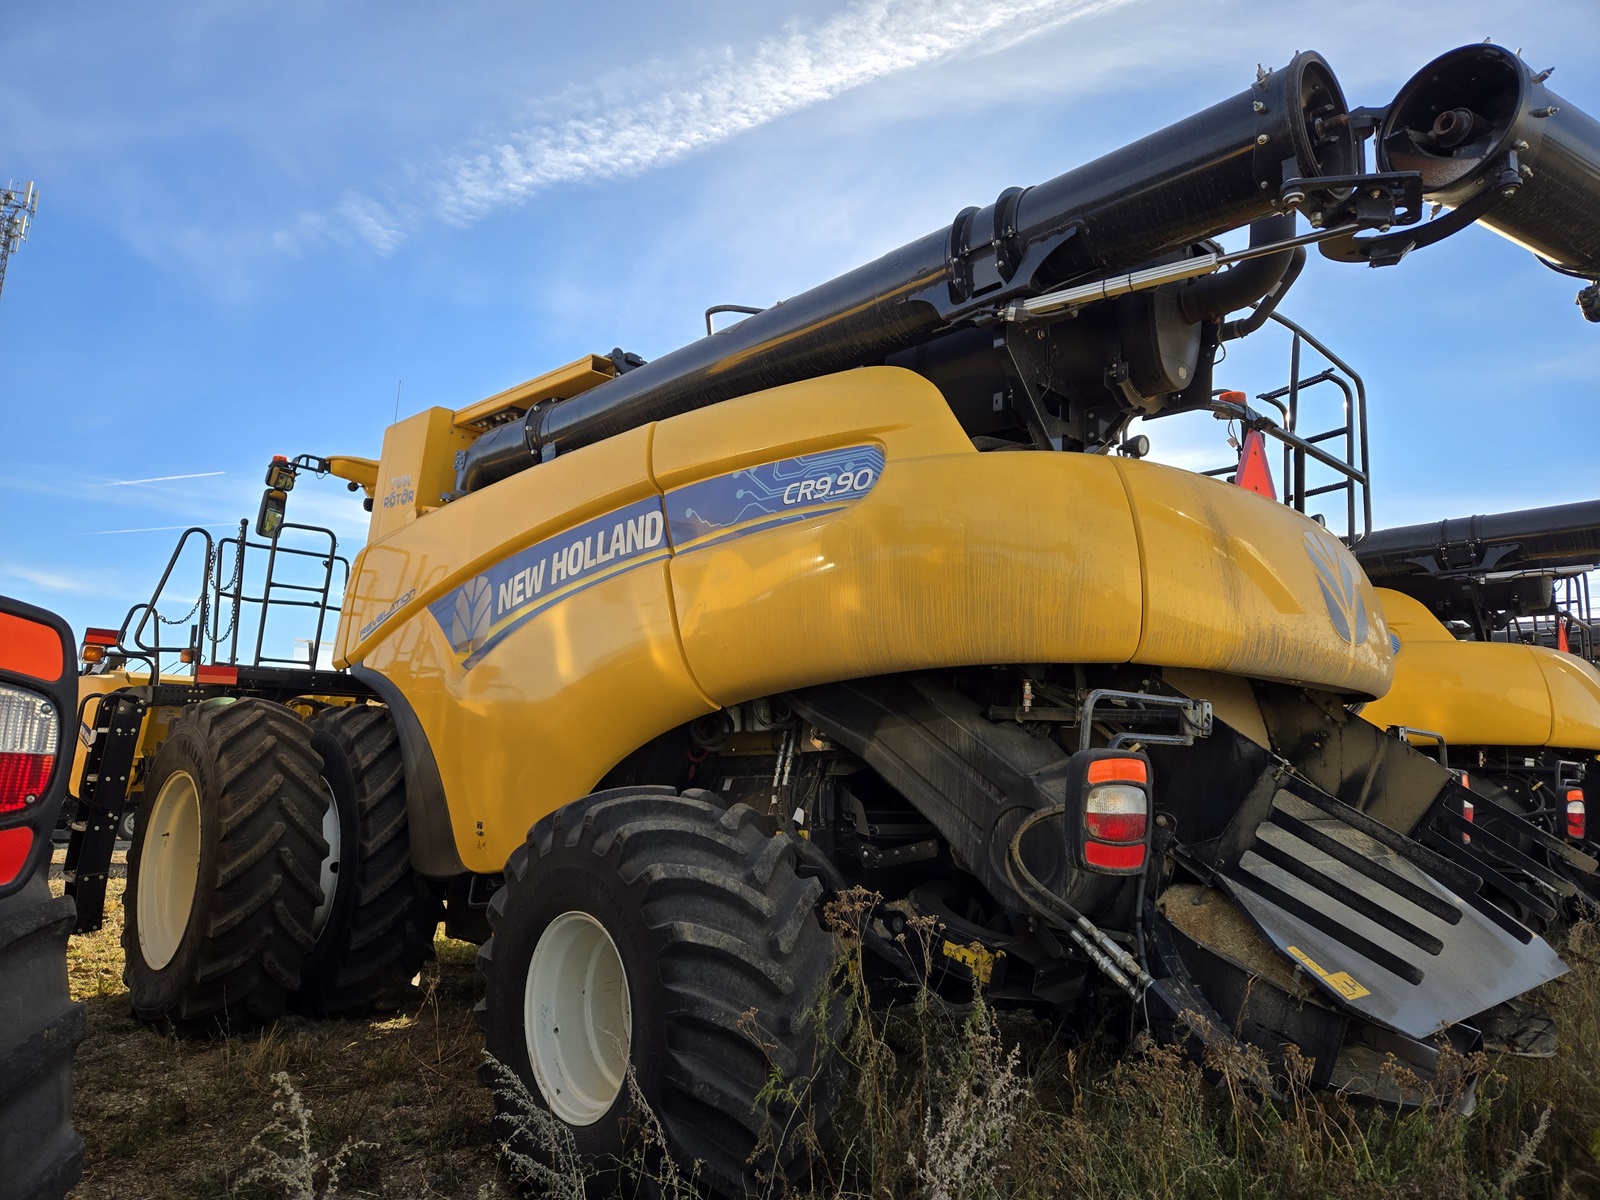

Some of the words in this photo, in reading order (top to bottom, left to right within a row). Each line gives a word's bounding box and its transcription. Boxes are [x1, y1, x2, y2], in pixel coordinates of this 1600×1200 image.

[384, 488, 415, 508] ROTOR
[390, 473, 412, 490] TWIN
[783, 467, 874, 505] CR9.90
[497, 558, 547, 615] NEW
[551, 510, 665, 586] HOLLAND
[360, 588, 416, 639] REVELATION
